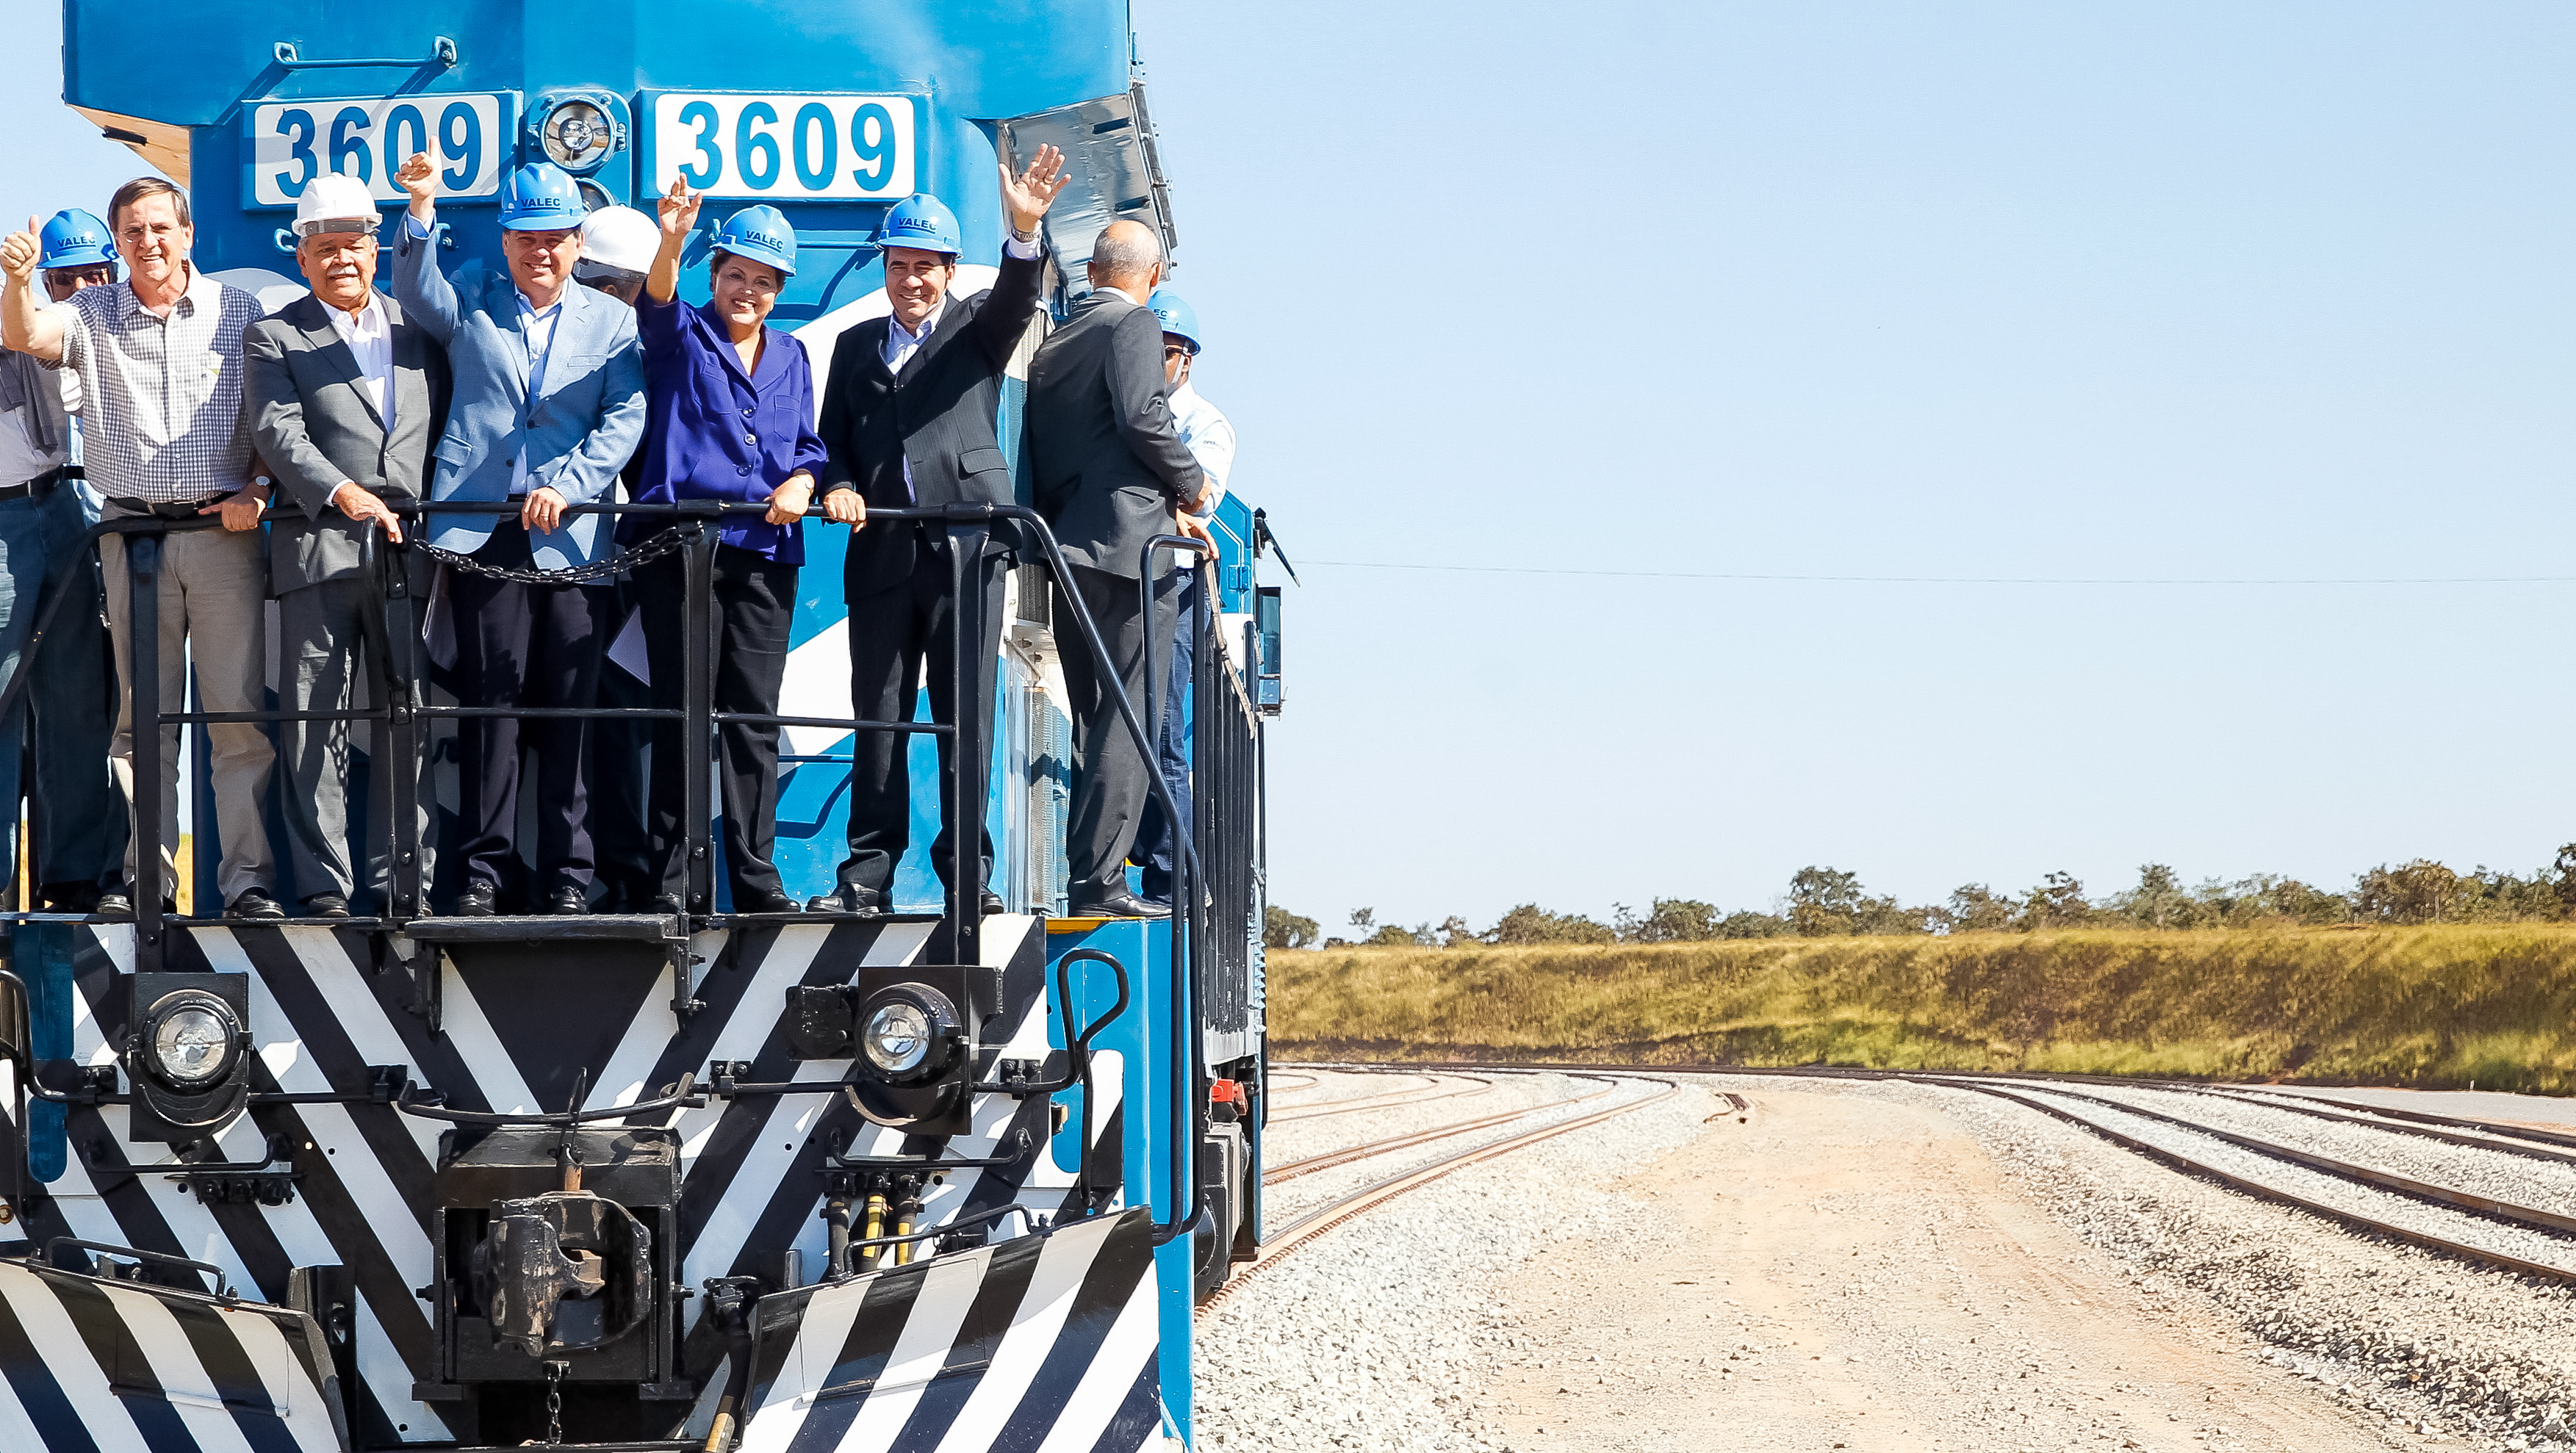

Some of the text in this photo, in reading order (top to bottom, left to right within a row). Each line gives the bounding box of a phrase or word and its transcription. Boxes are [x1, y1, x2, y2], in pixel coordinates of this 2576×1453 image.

[276, 101, 482, 198] 3609
[678, 100, 896, 192] 3609
[521, 198, 561, 207] VALEC
[897, 217, 936, 230] VALEC
[57, 236, 96, 248] VALEC
[746, 230, 784, 249] VALEC
